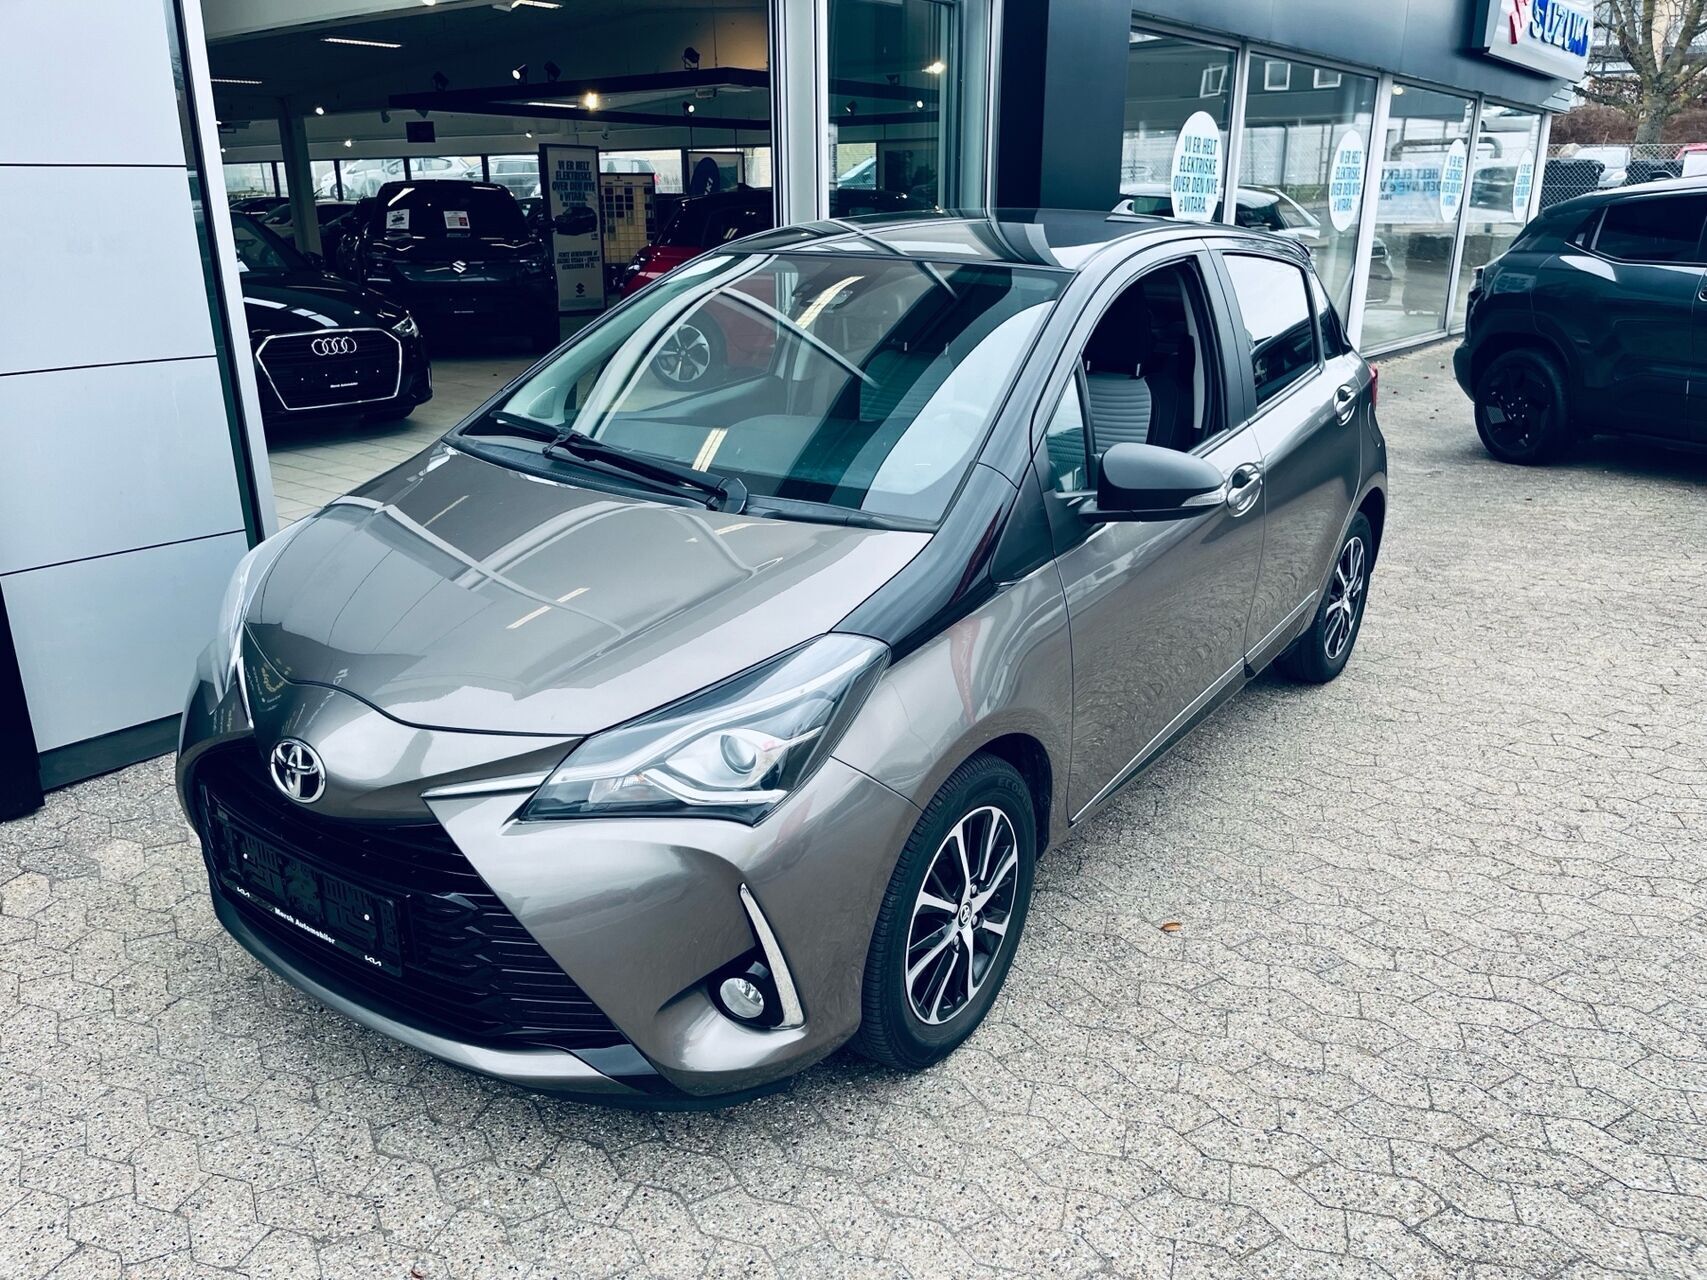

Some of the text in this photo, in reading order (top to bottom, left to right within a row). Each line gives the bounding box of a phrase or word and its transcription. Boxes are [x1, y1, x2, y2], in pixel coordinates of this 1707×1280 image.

[1529, 0, 1589, 57] SUZUKI
[1184, 136, 1218, 155] VI ER HELT
[1179, 155, 1217, 175] ELEKTRISKE
[1173, 175, 1218, 194] OVER DEN NYE
